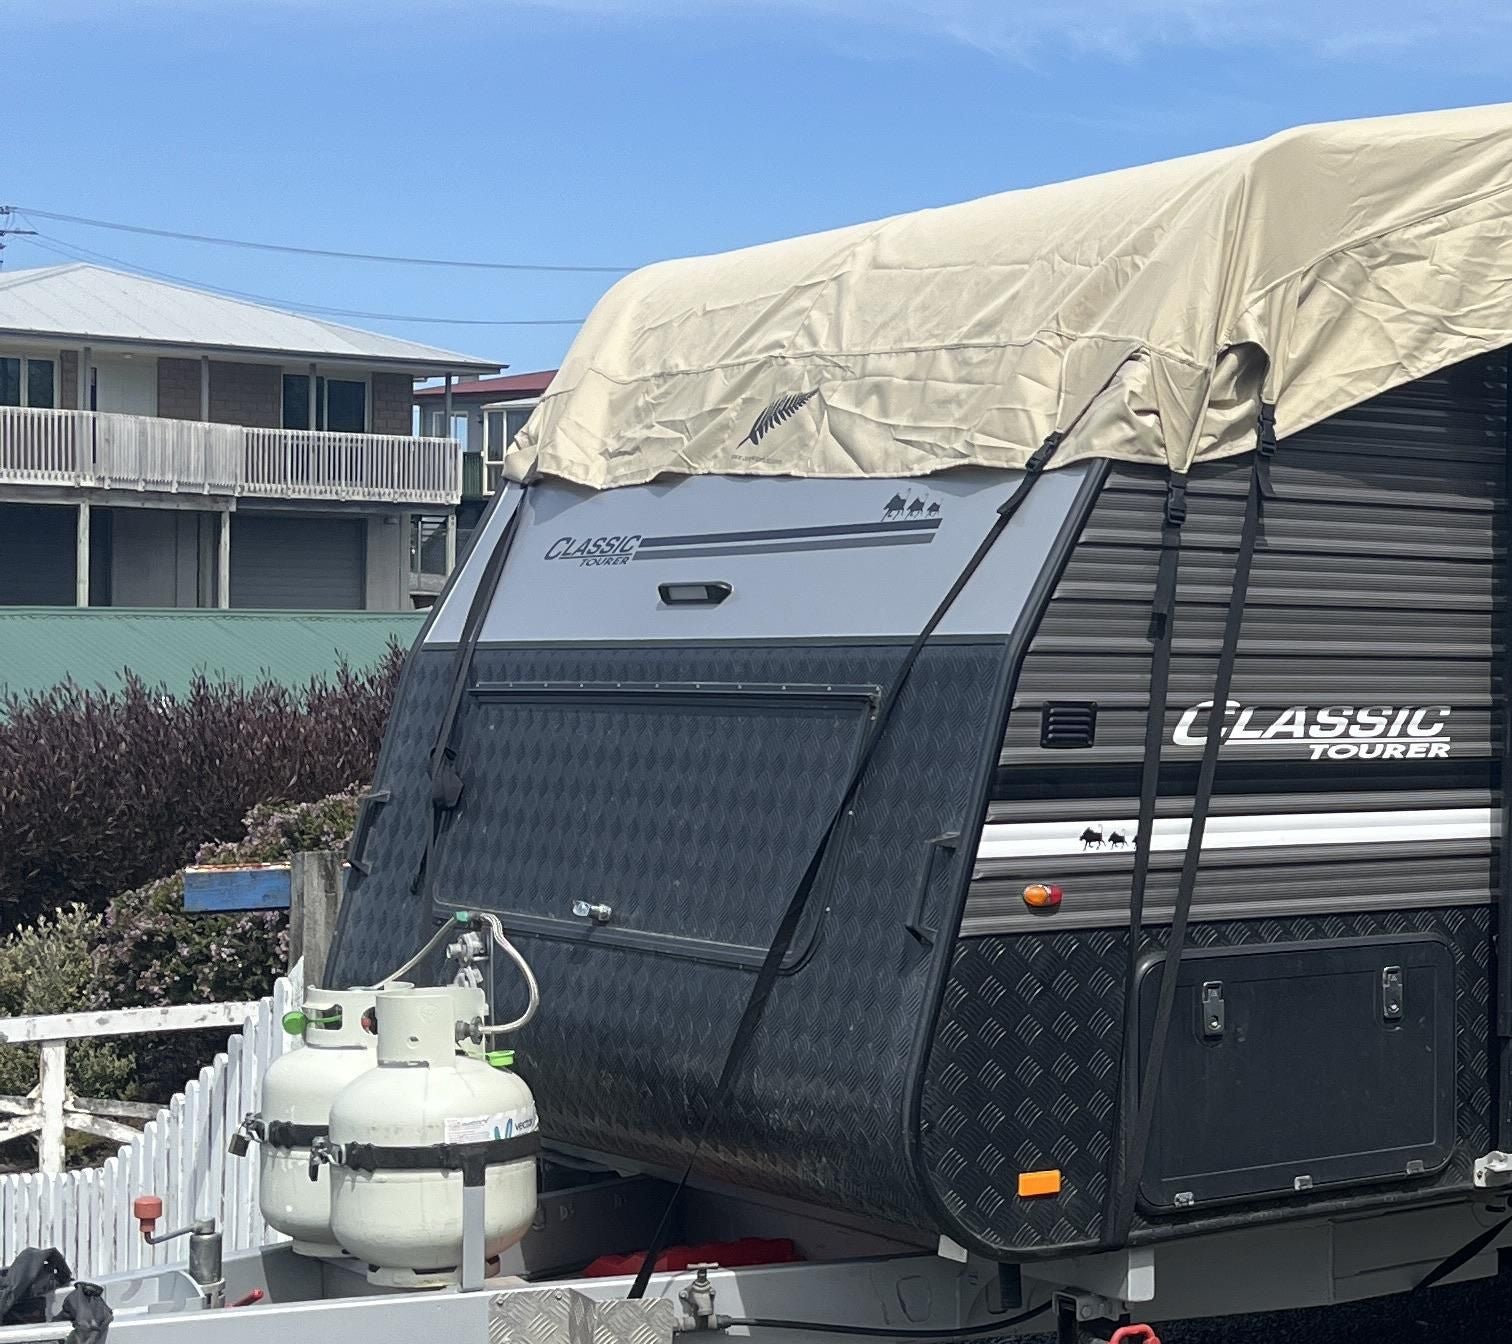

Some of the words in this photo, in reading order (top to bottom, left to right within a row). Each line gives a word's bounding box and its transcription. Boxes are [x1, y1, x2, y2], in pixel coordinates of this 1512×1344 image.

[544, 534, 642, 560] CLASSIC
[579, 556, 630, 567] TOURER
[1172, 699, 1451, 746] CLASSIC
[1309, 742, 1451, 760] TOURER
